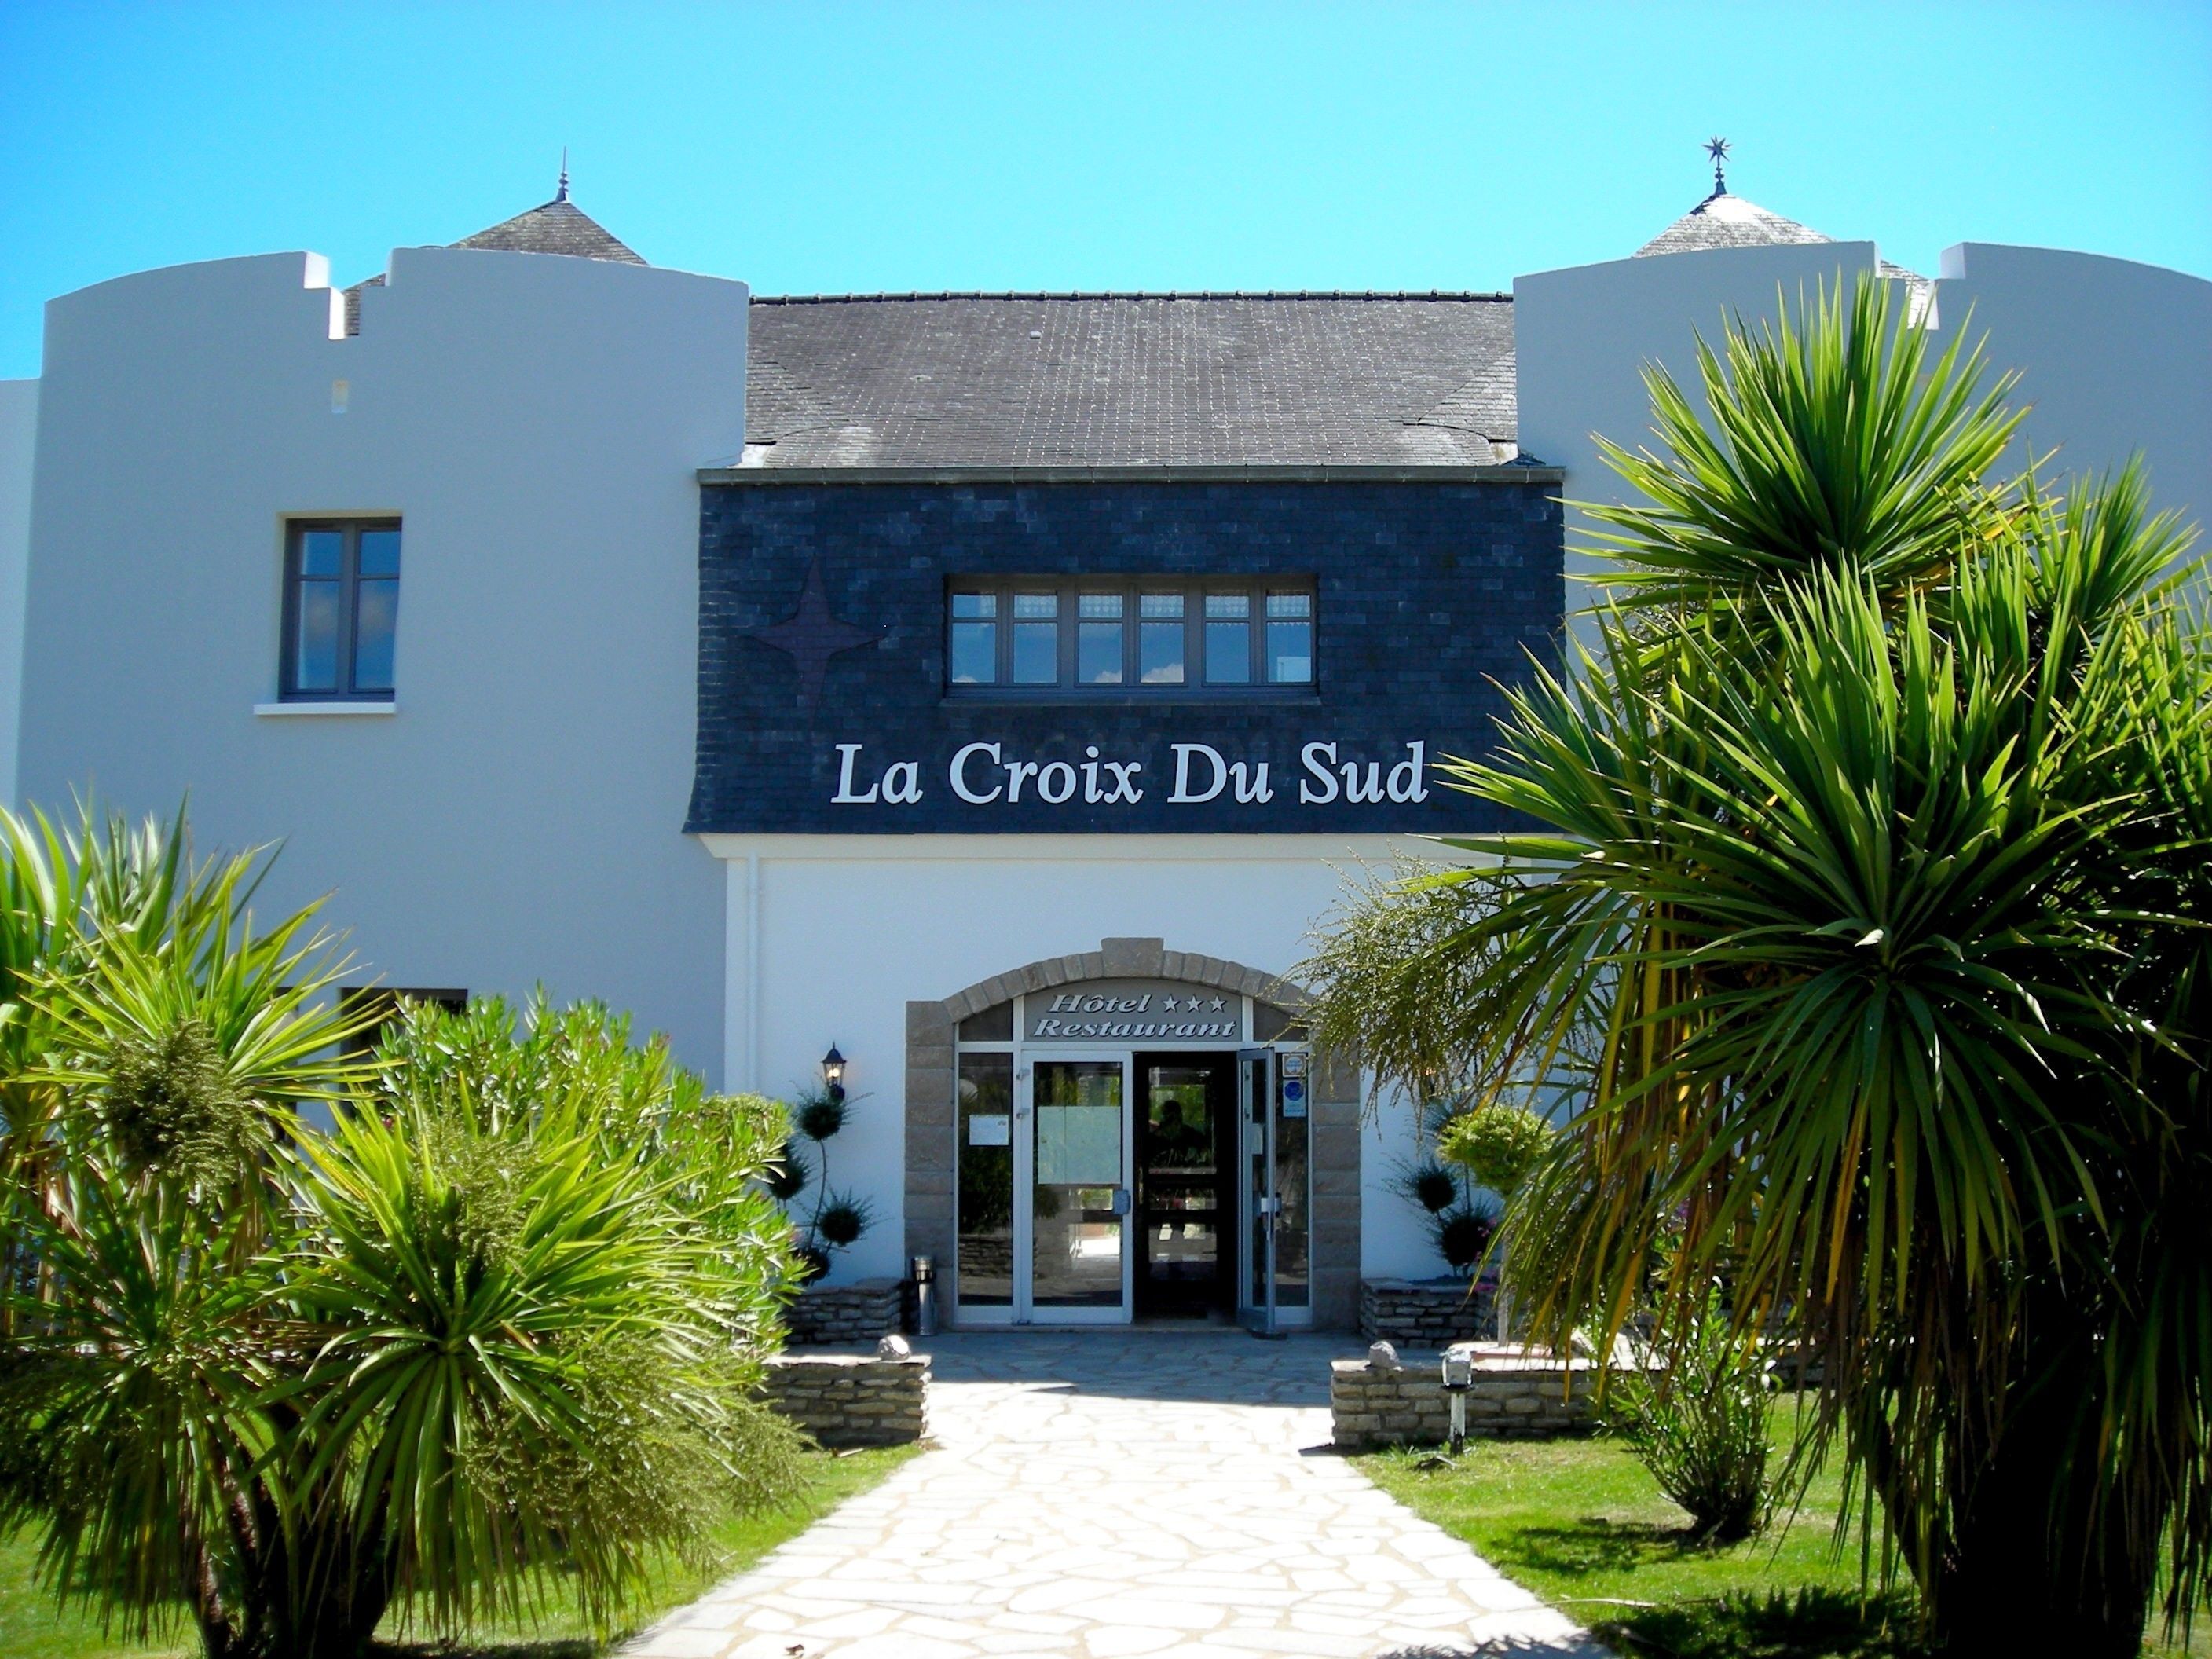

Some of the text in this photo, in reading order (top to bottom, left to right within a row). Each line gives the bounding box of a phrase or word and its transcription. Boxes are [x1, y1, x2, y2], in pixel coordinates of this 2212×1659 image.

[830, 740, 1429, 805] La Croix Du Sud
[1048, 994, 1152, 1013] Hôtel
[1033, 1019, 1237, 1038] Restaurant
